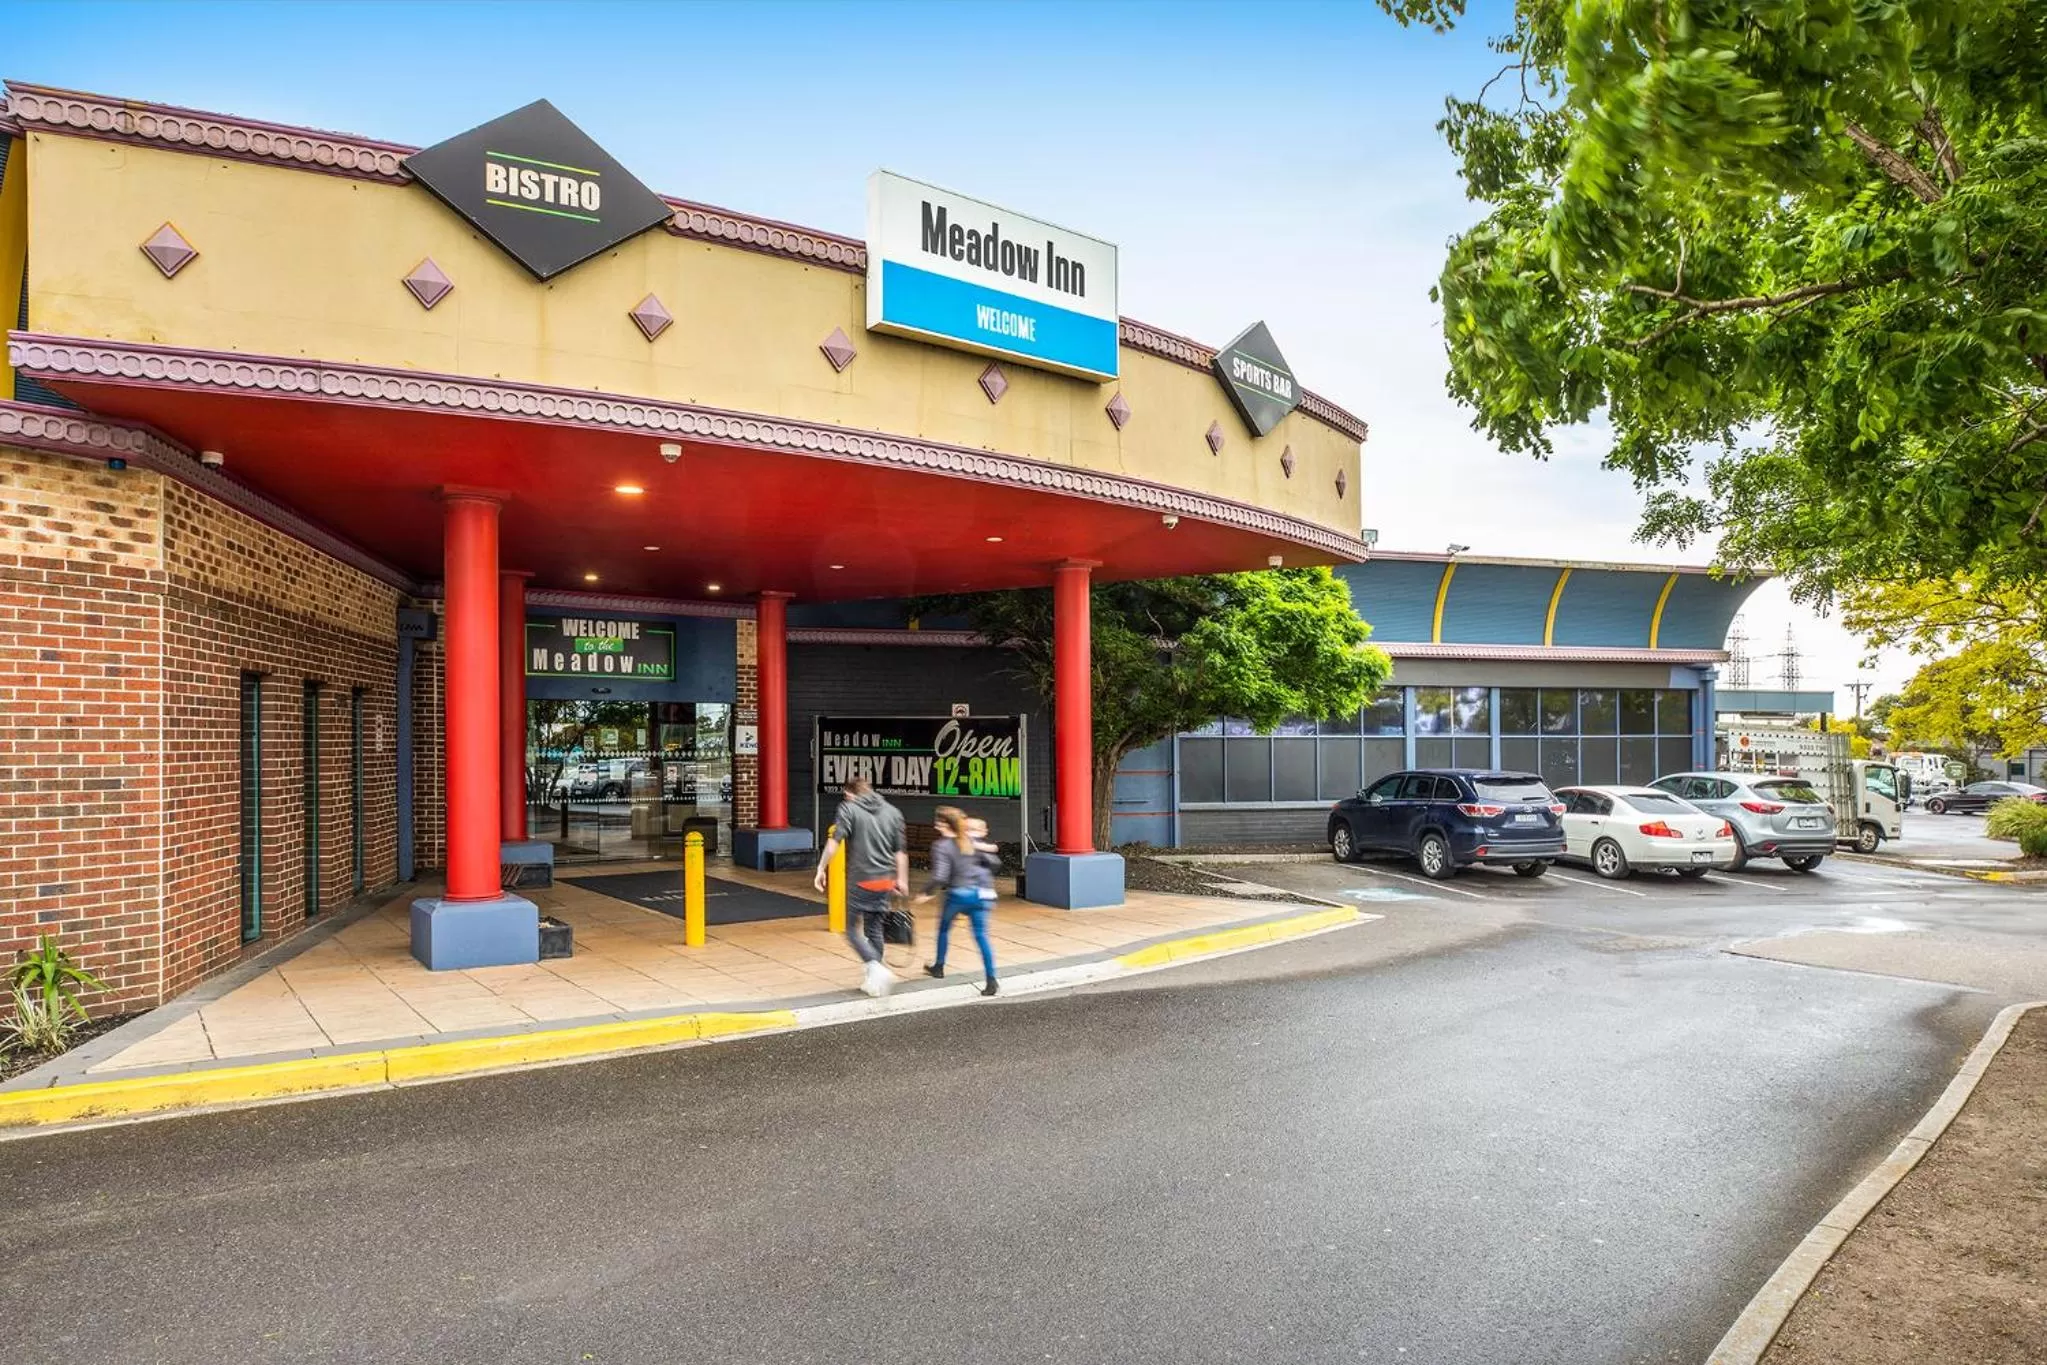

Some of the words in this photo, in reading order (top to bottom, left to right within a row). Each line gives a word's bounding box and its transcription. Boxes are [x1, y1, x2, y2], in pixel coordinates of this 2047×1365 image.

[485, 162, 601, 211] BISTRO
[921, 200, 1039, 283] Meadow
[1046, 240, 1085, 297] Inn
[976, 304, 1036, 342] WELCOME
[1232, 357, 1272, 390] SPORTS
[1273, 374, 1292, 400] BAR
[562, 618, 640, 640] WELCOME
[583, 642, 594, 651] to
[598, 639, 615, 650] the
[532, 648, 634, 673] Meadow
[637, 663, 669, 674] INN
[823, 731, 881, 748] Meadow
[882, 739, 902, 748] INN
[934, 719, 1014, 766] Open
[823, 755, 887, 785] EVERY
[891, 756, 932, 786] DAY
[933, 756, 1022, 796] 12-8AM
